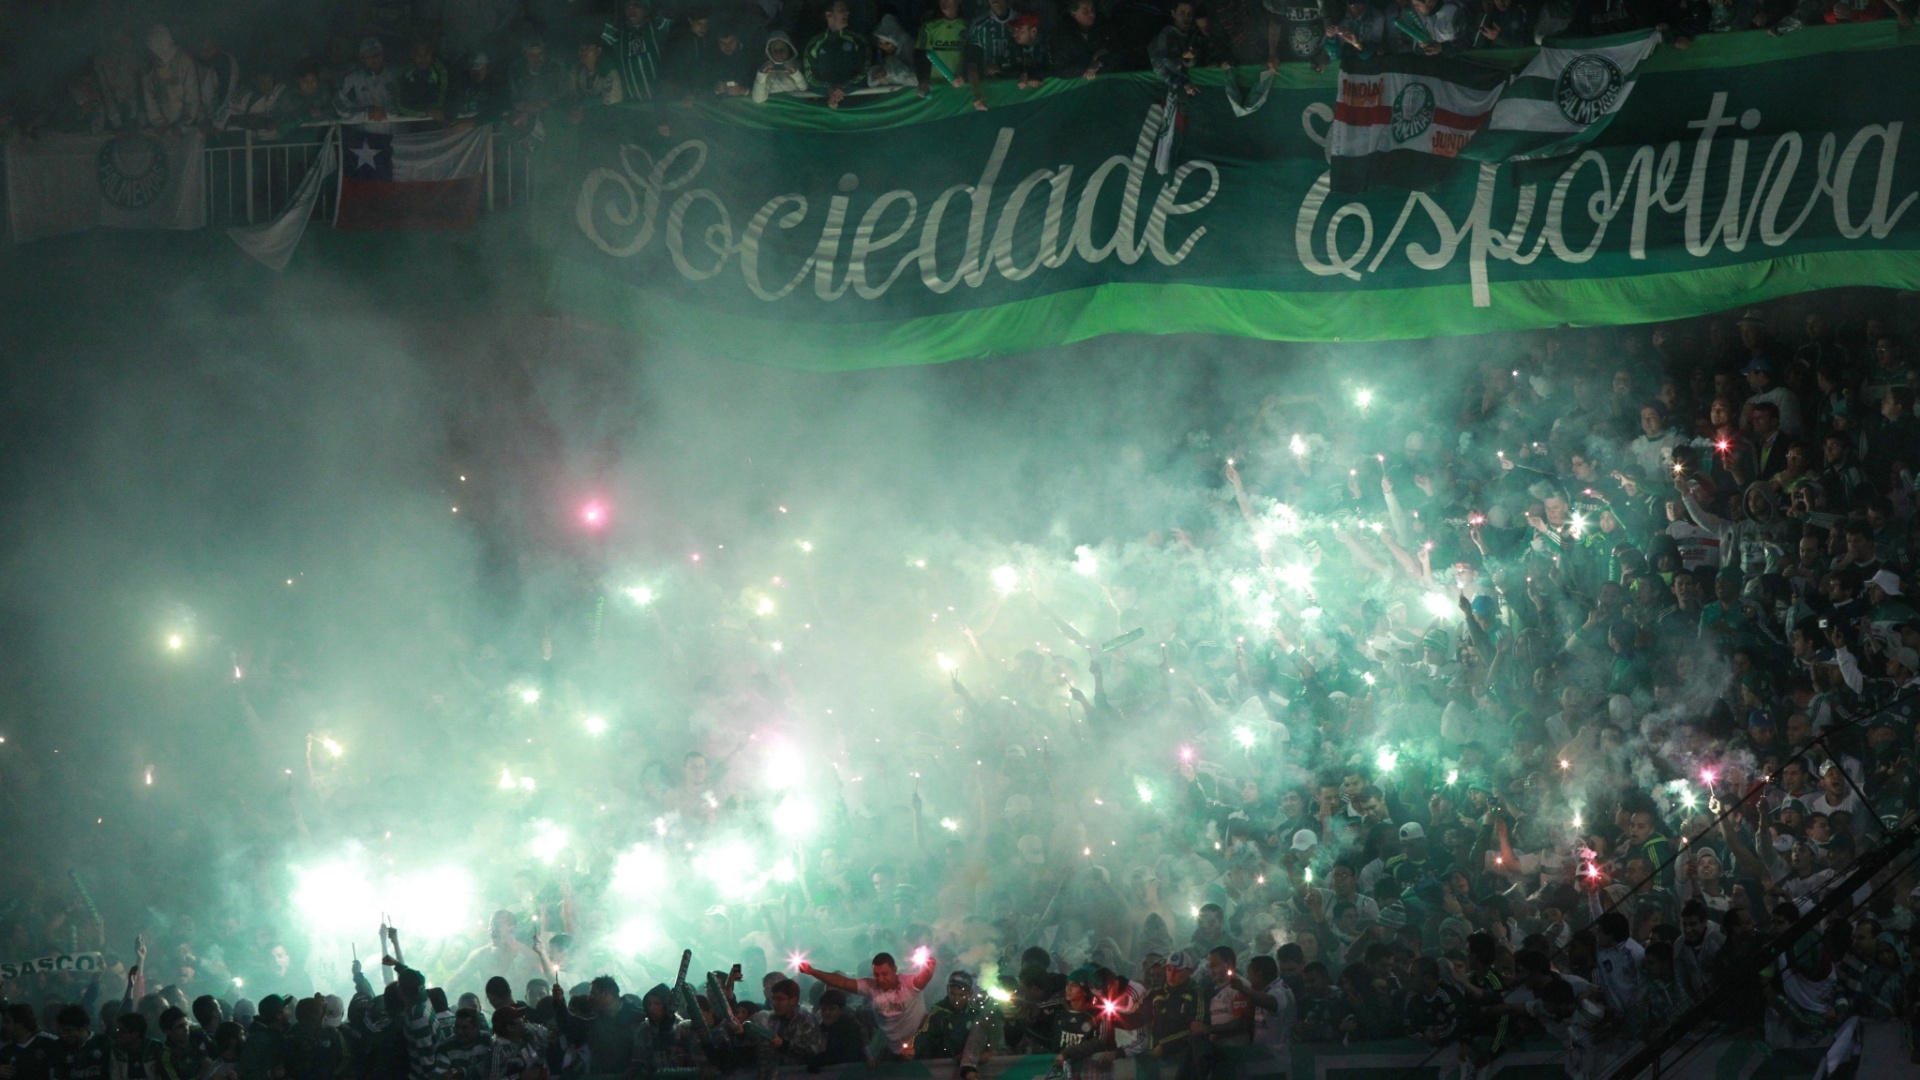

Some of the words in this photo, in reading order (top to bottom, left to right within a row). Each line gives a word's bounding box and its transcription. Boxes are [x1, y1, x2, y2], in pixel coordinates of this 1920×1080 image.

[1559, 84, 1620, 124] PALMEIRAS
[101, 163, 167, 206] PALMEIRAS
[577, 103, 1220, 301] Sociedade
[1295, 91, 1920, 307] Esportiva
[1060, 1030, 1085, 1048] FIAT
